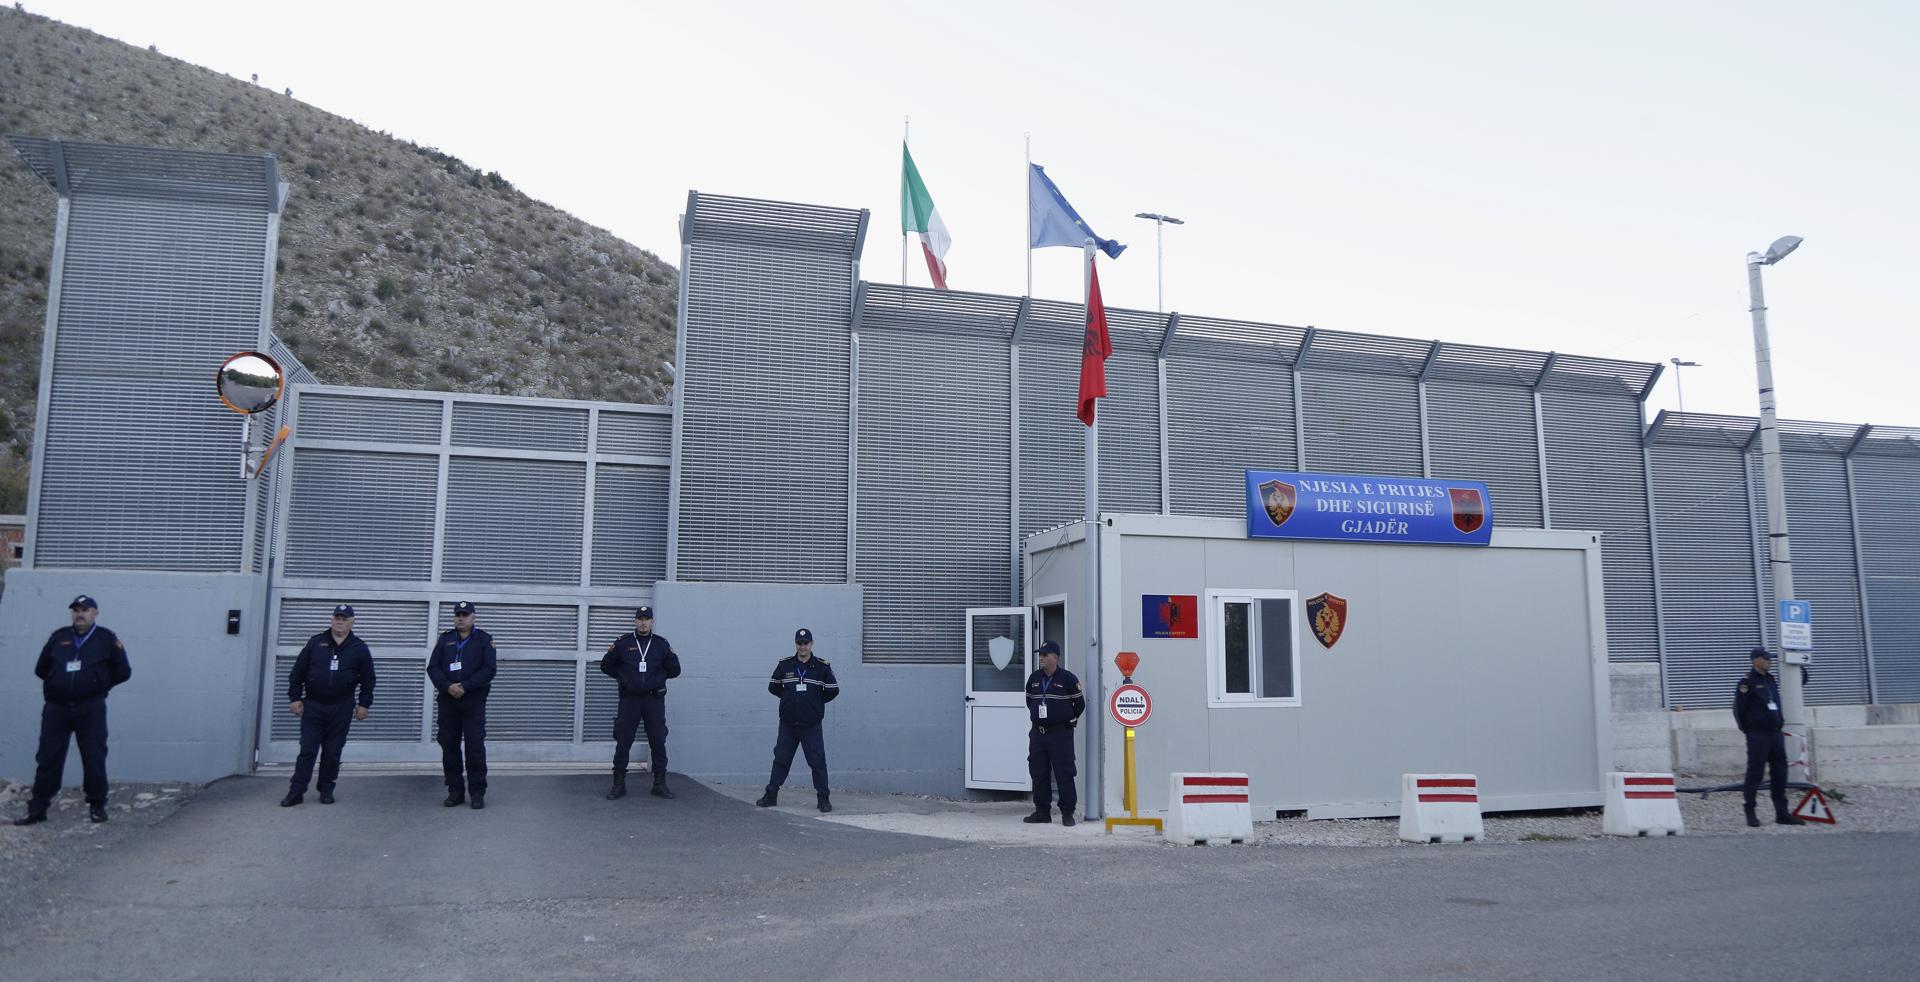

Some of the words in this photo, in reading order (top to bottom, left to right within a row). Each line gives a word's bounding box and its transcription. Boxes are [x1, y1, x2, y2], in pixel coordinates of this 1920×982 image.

[1298, 479, 1360, 495] NJESIA
[1364, 483, 1374, 495] E
[1379, 483, 1444, 498] PRITJES
[1317, 499, 1352, 513] DHE
[1357, 499, 1435, 516] SIGURISË
[1341, 519, 1409, 535] GJADËR
[1790, 605, 1801, 619] P
[1119, 696, 1143, 704] NDAL!
